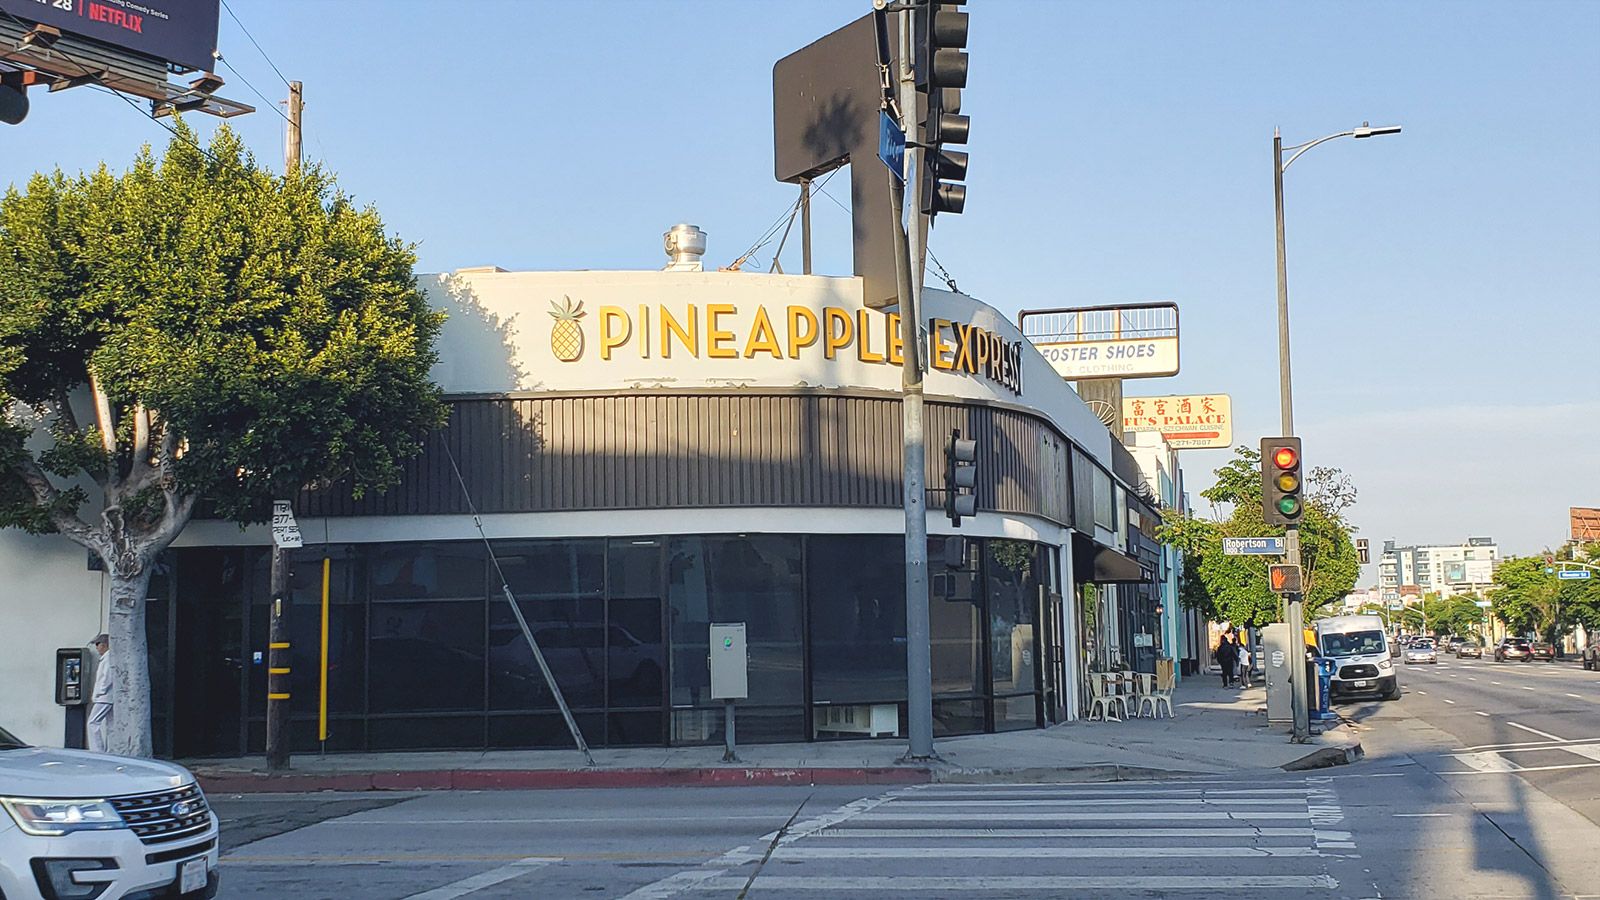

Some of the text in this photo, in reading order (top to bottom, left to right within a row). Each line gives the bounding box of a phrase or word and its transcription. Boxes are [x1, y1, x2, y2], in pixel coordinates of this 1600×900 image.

[88, 2, 143, 33] NETFLIX
[126, 1, 150, 15] Comedy
[150, 9, 169, 20] Series
[600, 303, 1024, 397] PINEAPPLE EXPRESS
[1042, 344, 1156, 363] FOSTER SHOES
[1079, 363, 1134, 374] CLOTHING
[1124, 414, 1226, 426] FU'S PALACE
[1225, 539, 1284, 548] Robertson Bl
